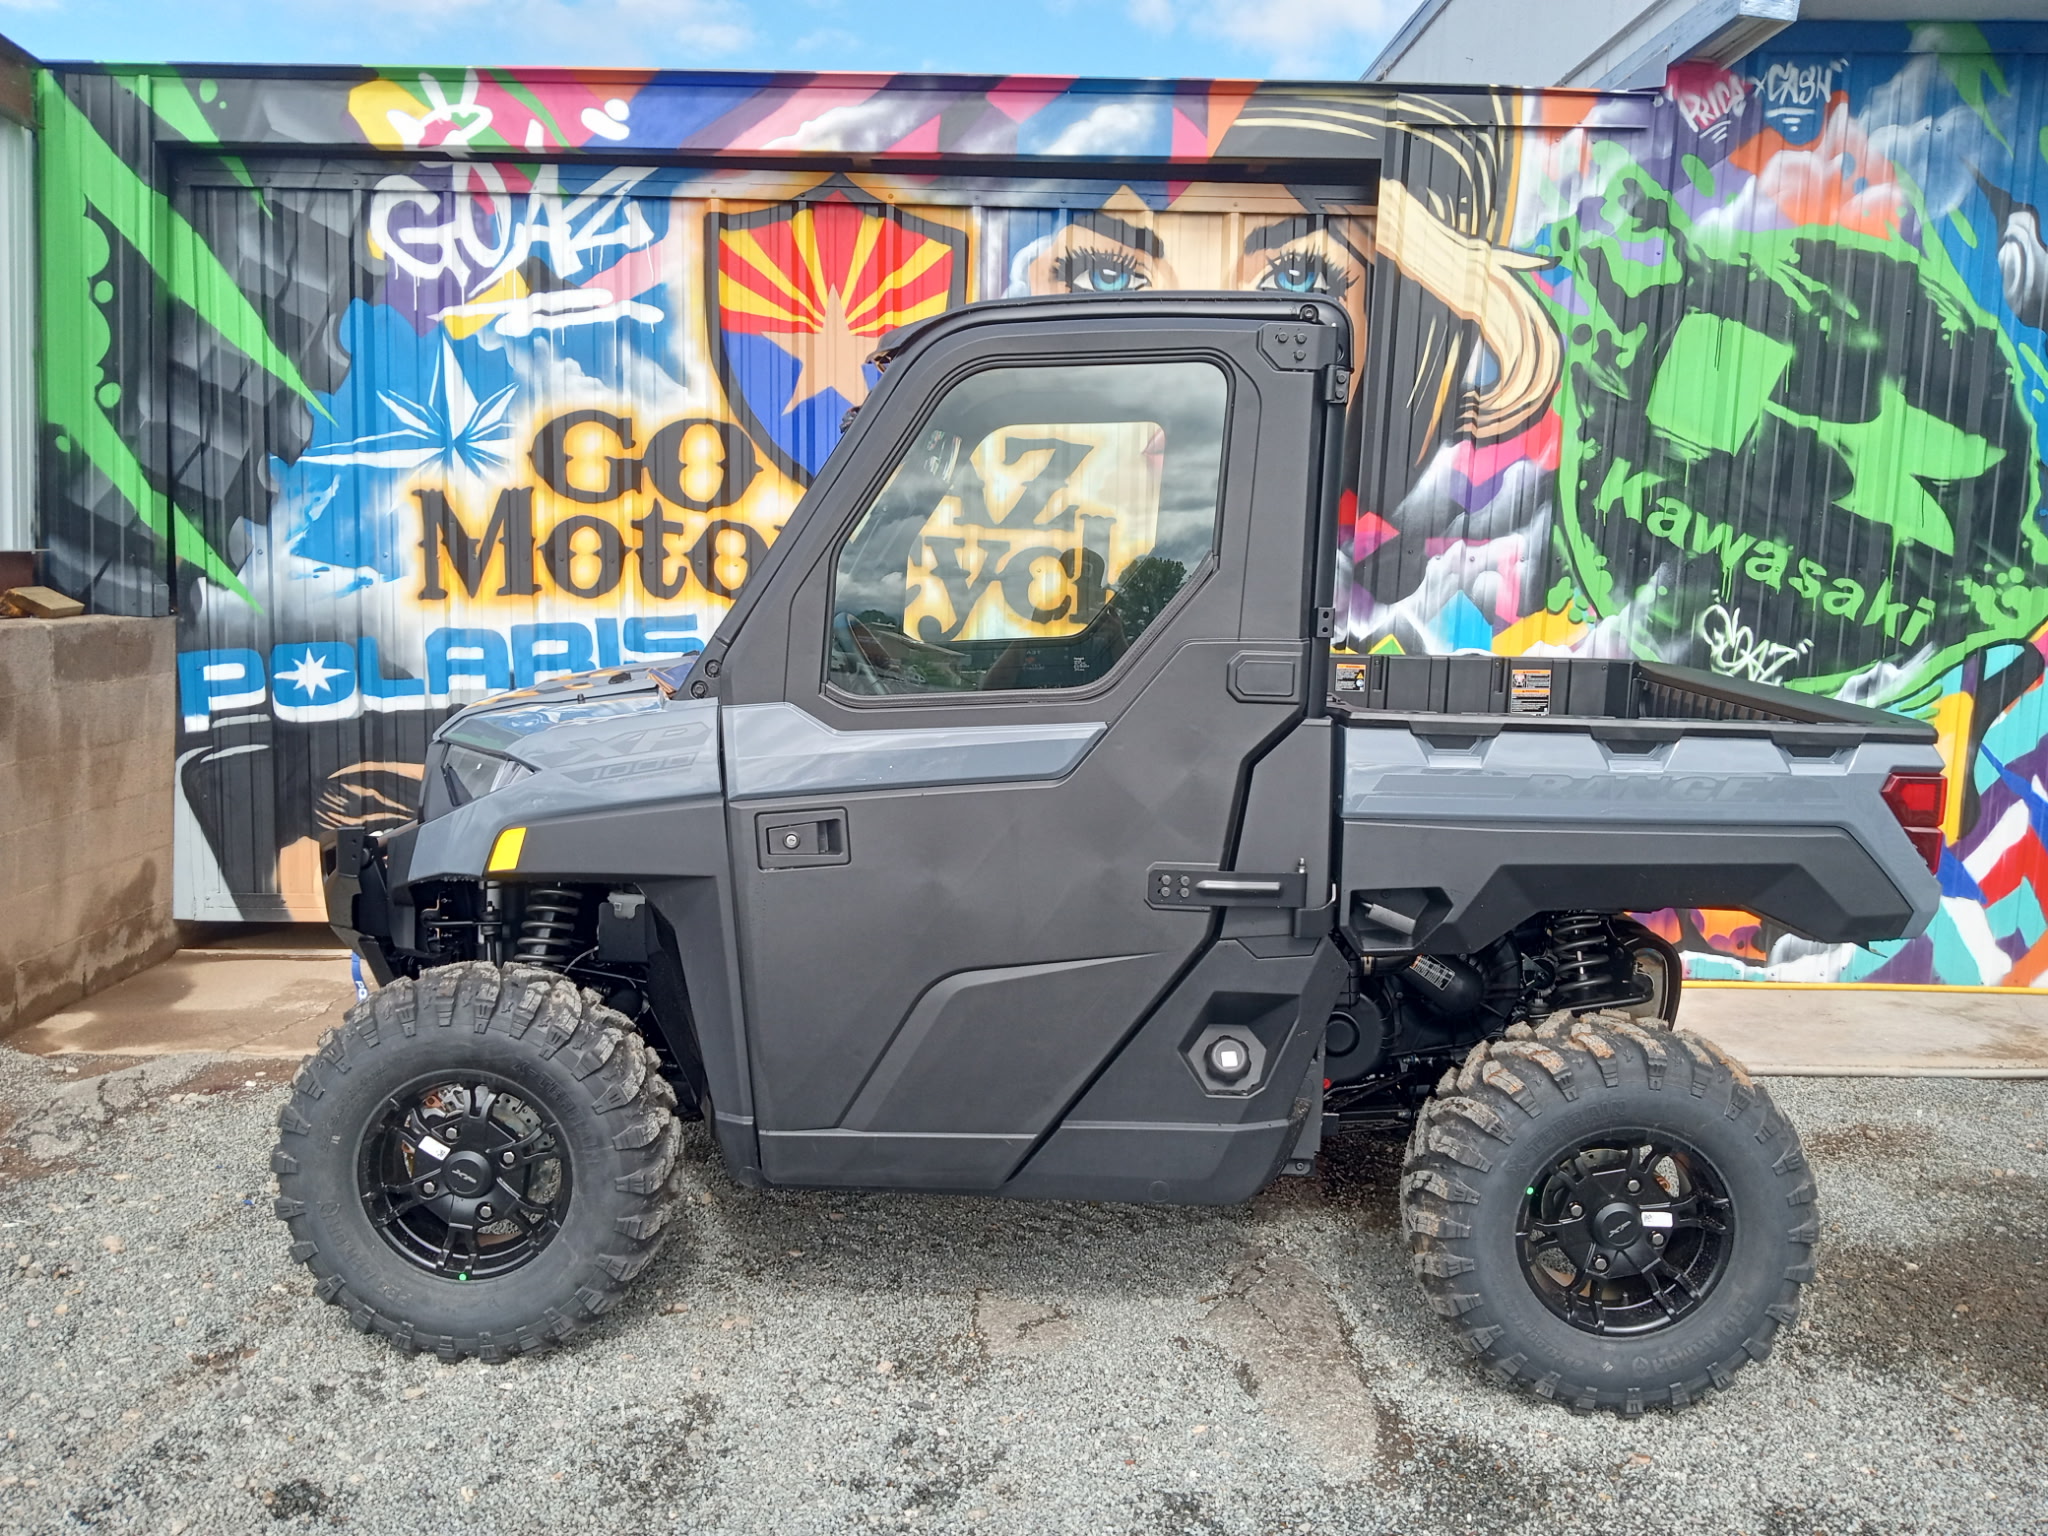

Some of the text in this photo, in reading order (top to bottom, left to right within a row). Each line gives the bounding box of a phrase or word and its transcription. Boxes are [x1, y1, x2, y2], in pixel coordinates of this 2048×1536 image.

[526, 409, 764, 513] GO
[1592, 456, 1937, 648] Kawasaki
[177, 614, 707, 732] POLARIS
[546, 721, 713, 769] XP
[590, 751, 700, 781] 1000
